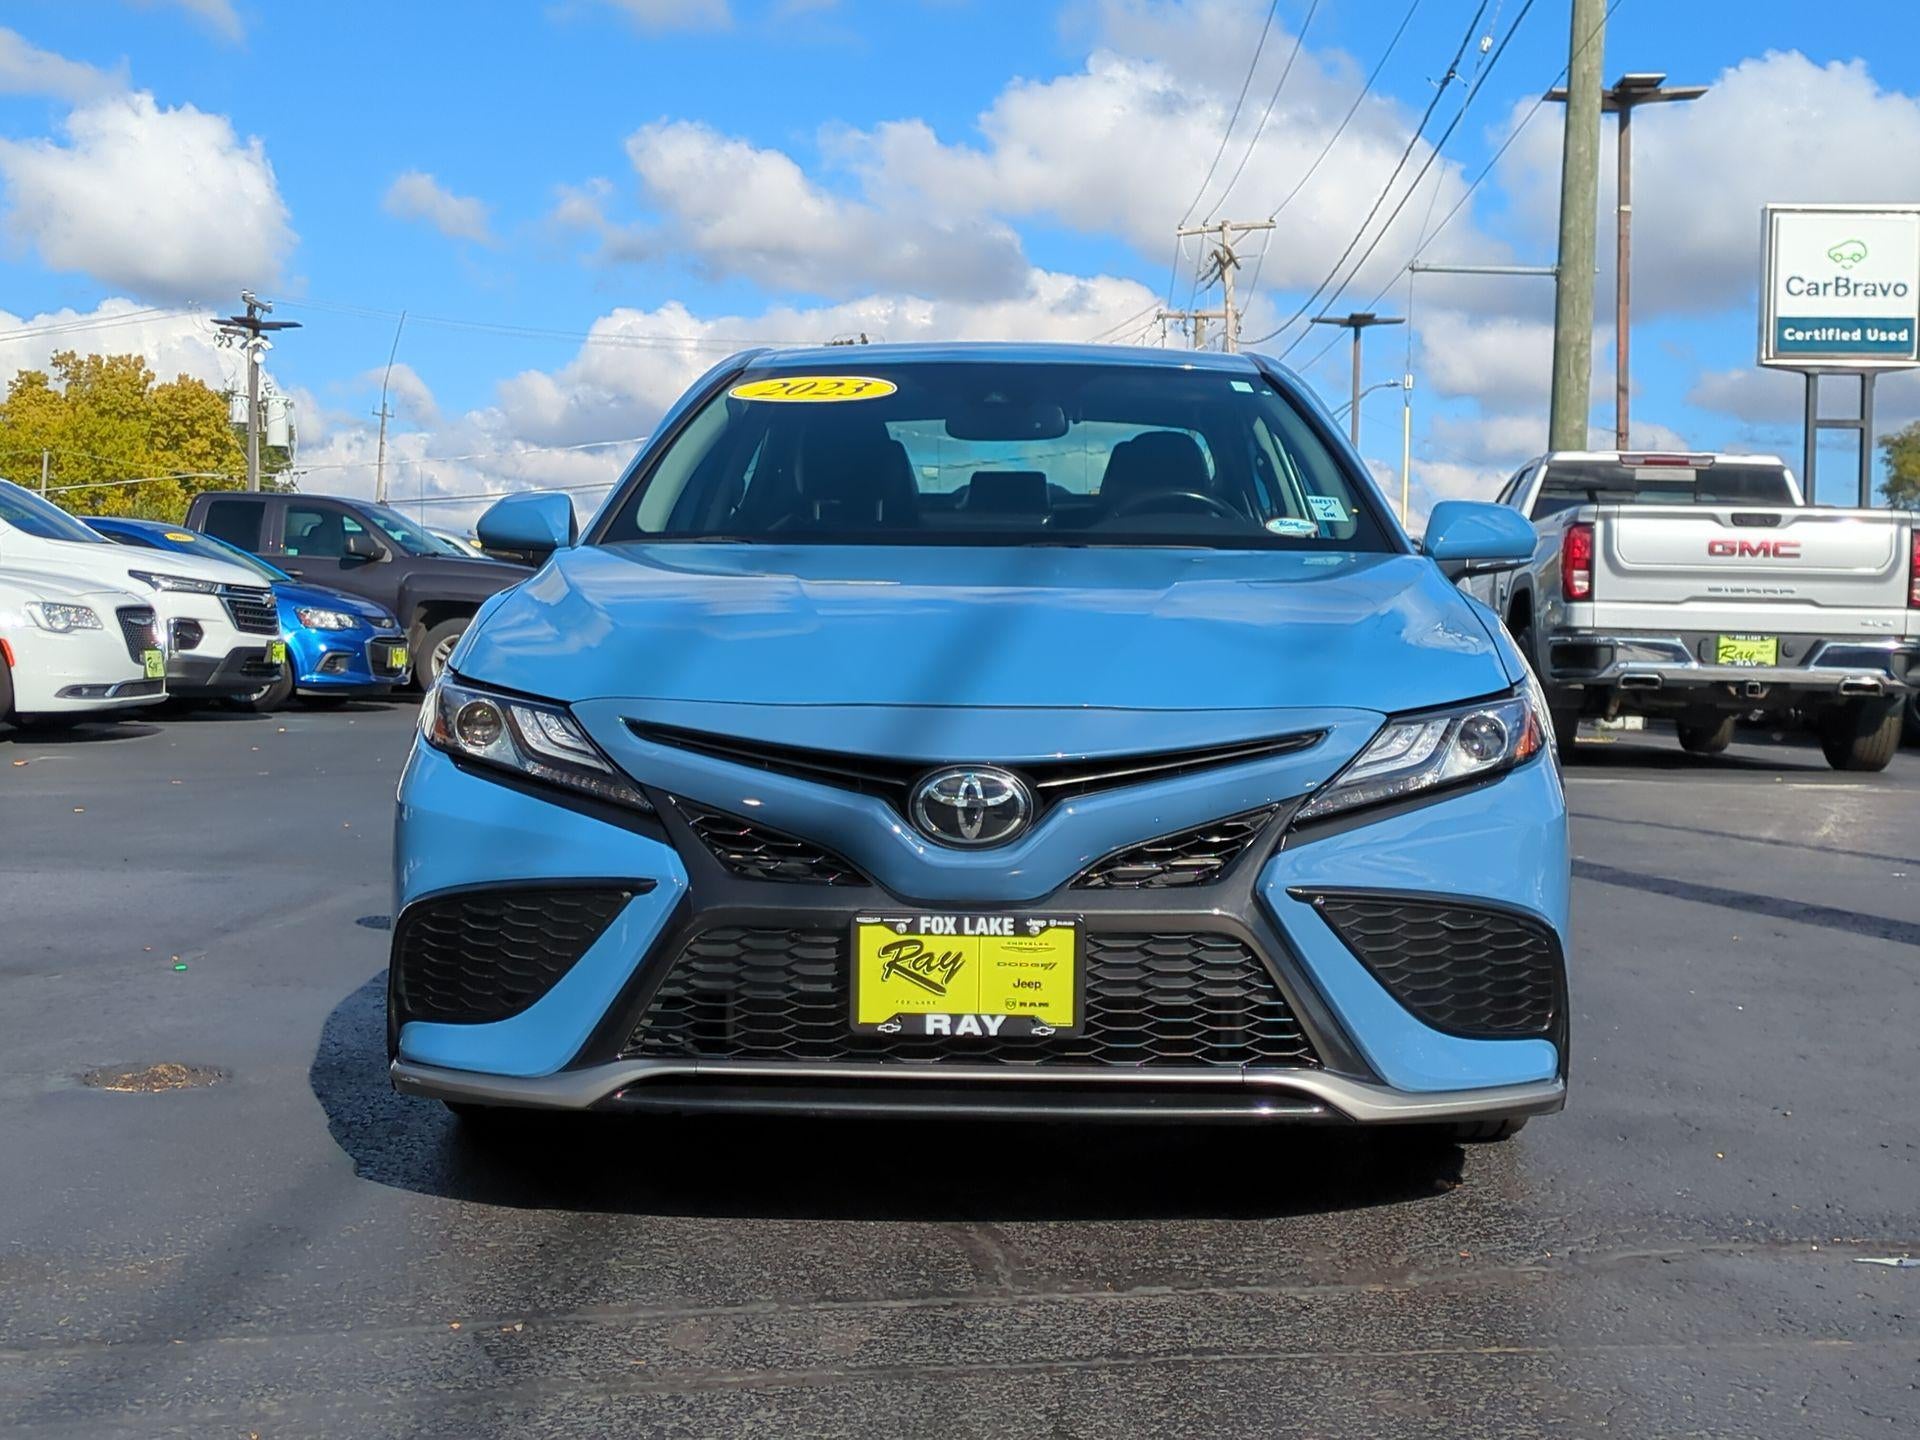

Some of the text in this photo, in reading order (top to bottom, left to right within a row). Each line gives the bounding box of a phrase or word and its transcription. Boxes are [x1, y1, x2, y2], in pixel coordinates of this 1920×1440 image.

[1786, 275, 1908, 297] CarBravo
[1784, 328, 1909, 342] Certified Used
[754, 381, 873, 396] 2023
[1708, 540, 1801, 558] GMC
[1717, 644, 1755, 662] Ray
[919, 916, 1015, 936] FOX LAKE
[878, 939, 966, 996] Ray
[1013, 978, 1042, 991] Jeep
[925, 1013, 1007, 1036] RAY
